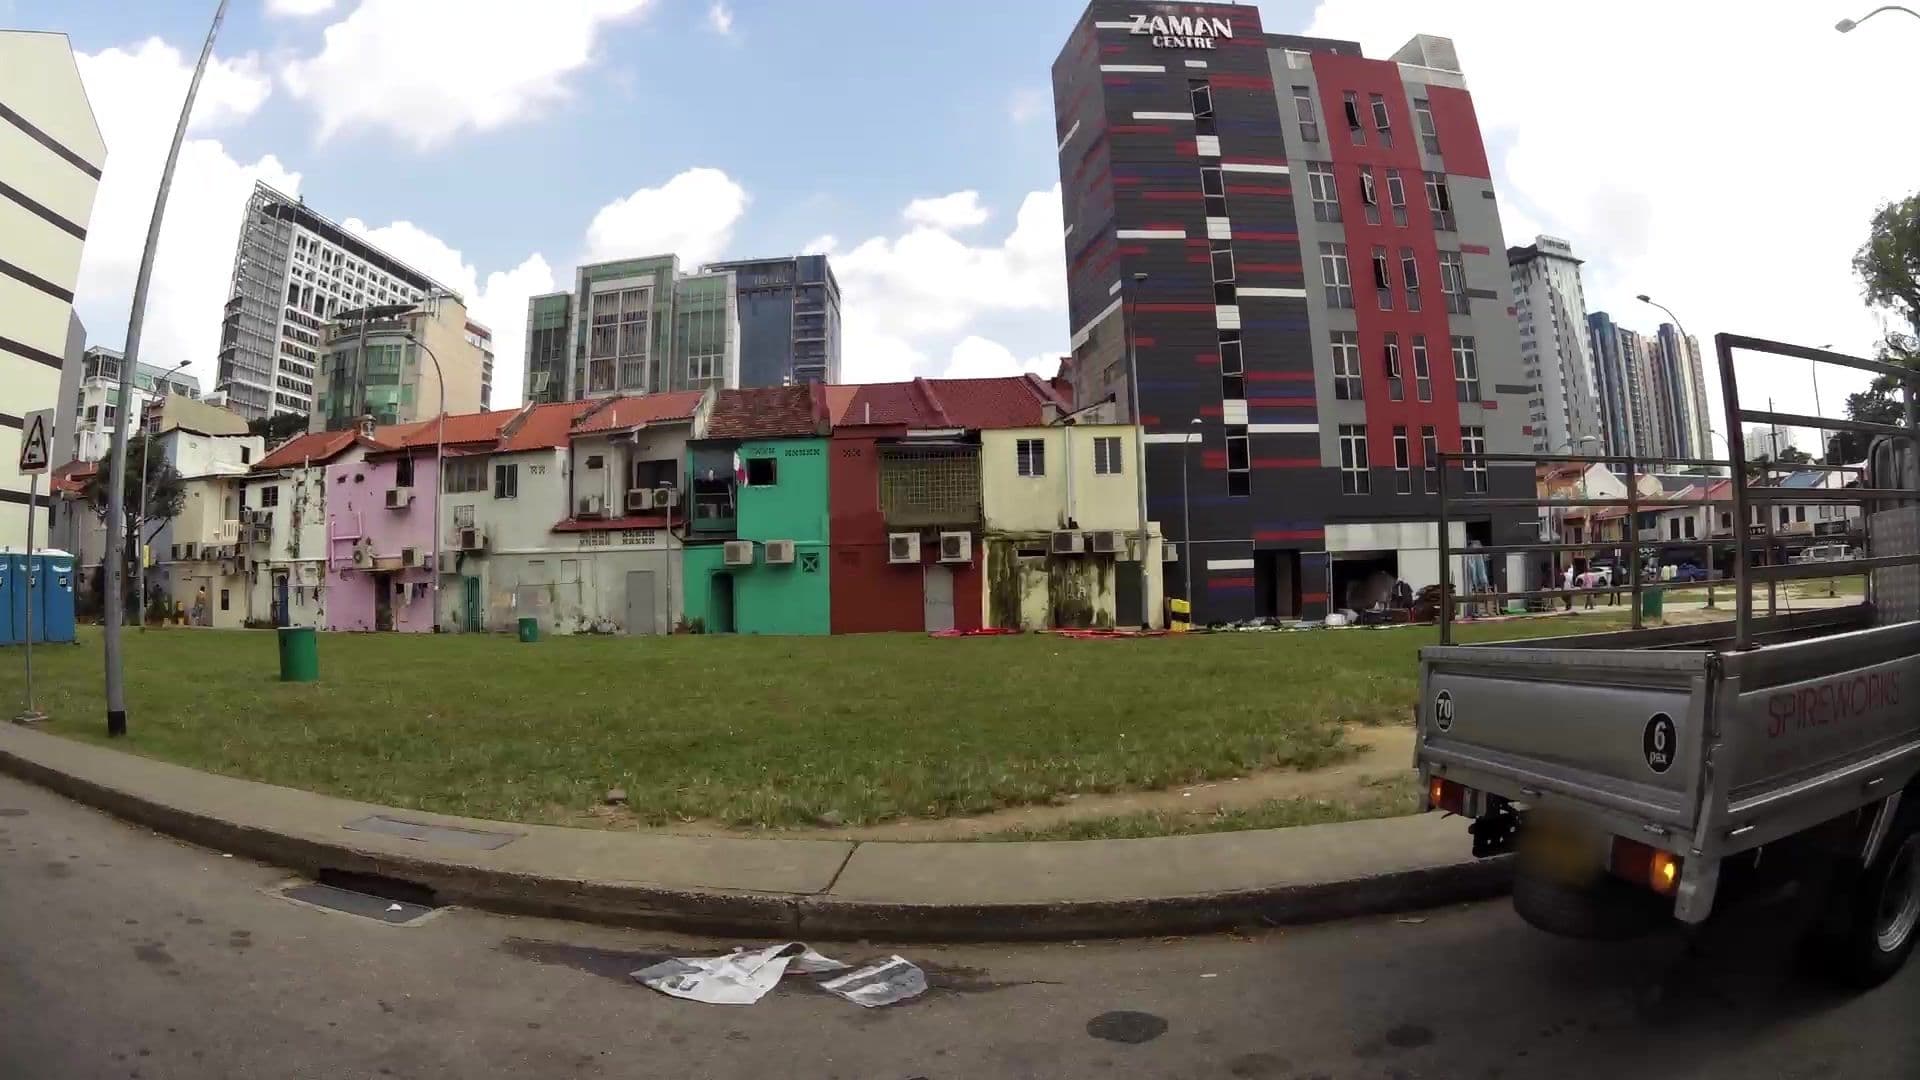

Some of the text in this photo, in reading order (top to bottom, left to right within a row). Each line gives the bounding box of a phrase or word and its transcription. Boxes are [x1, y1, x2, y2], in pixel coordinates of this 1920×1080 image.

[1129, 14, 1233, 38] ZAMAN
[1152, 35, 1217, 49] CENTRE
[1437, 698, 1451, 719] 70
[1767, 672, 1901, 738] SPIREWORKS
[1654, 721, 1666, 751] 6
